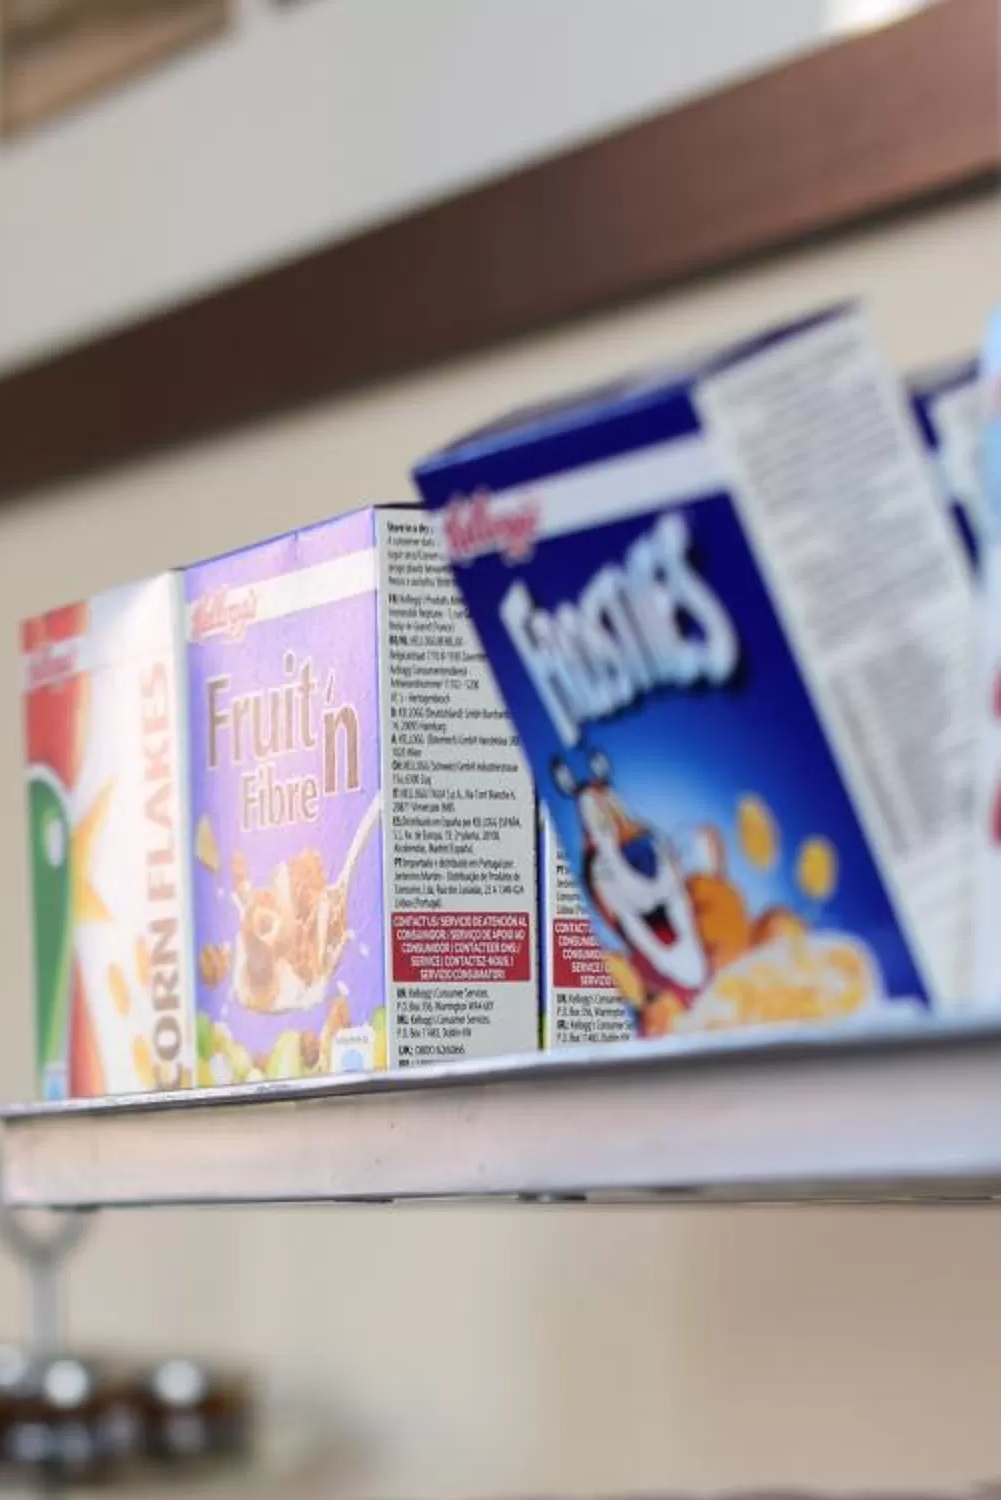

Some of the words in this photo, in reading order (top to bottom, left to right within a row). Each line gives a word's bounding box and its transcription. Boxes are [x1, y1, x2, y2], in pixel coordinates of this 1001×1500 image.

[206, 649, 318, 770] Fruit
[141, 661, 177, 902] FLAKES
[241, 761, 319, 832] Fibre
